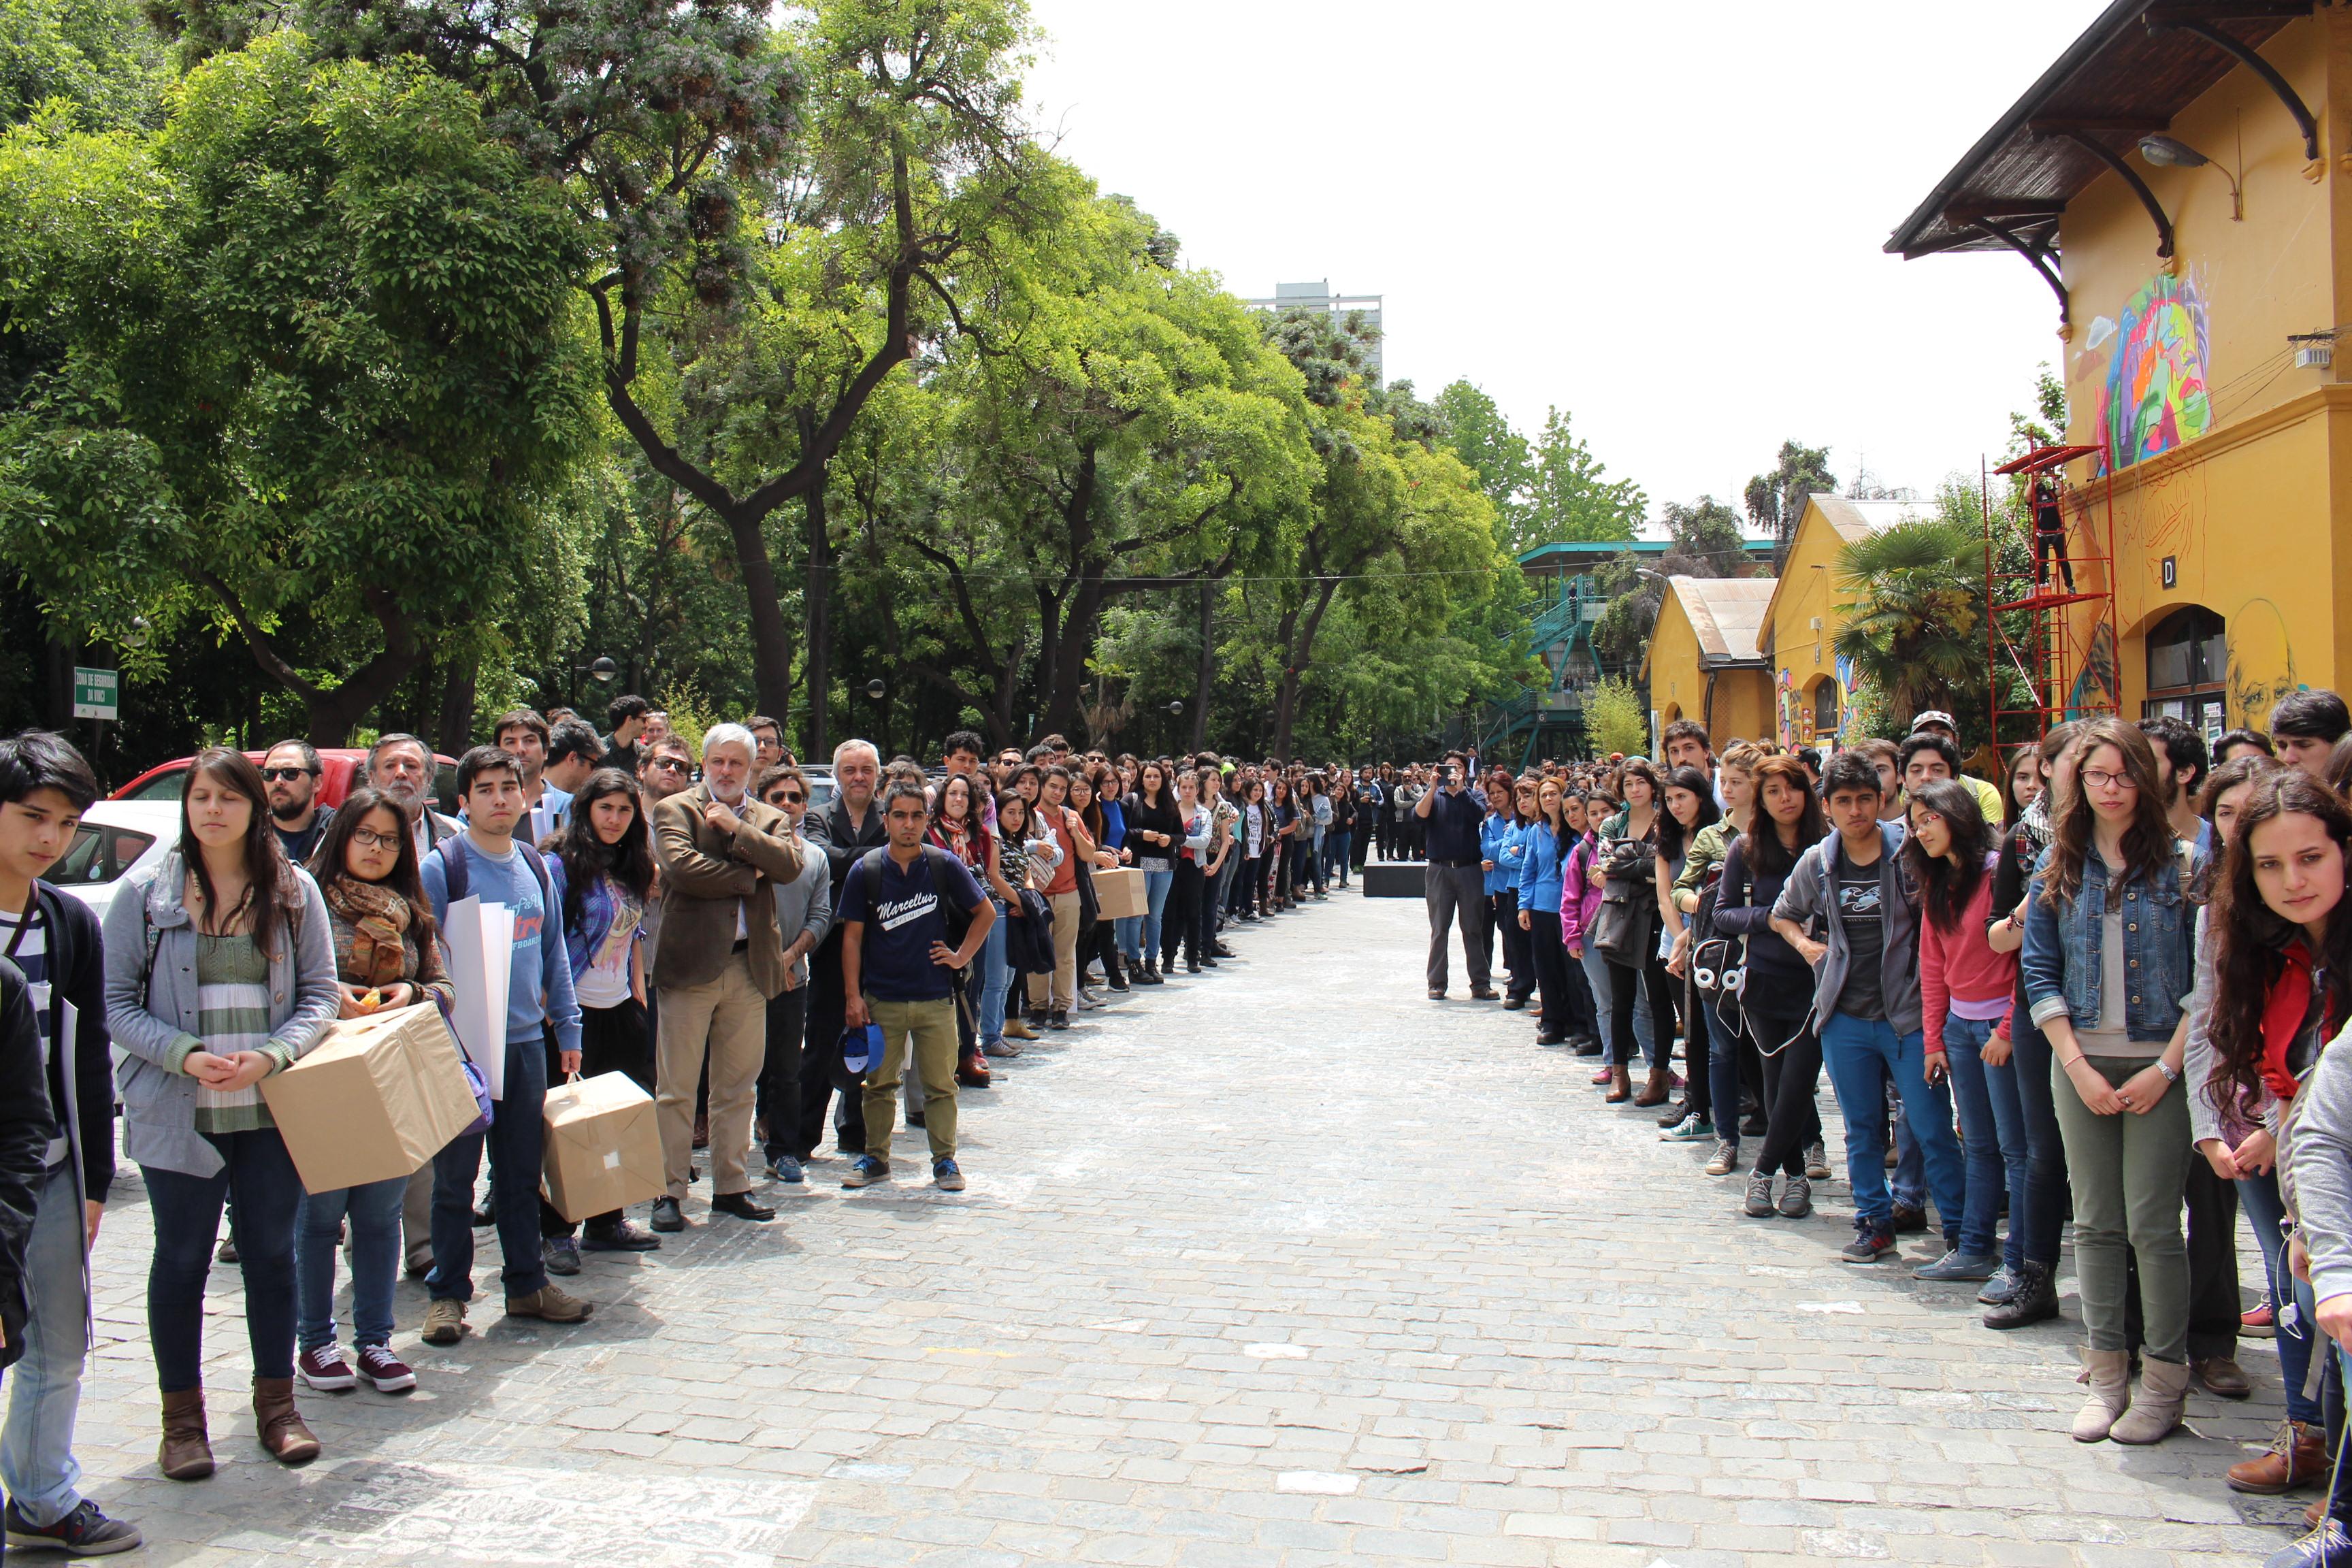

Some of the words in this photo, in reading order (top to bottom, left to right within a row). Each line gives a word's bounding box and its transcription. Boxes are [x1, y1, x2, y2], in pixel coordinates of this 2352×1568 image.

[2165, 561, 2172, 584] D
[76, 672, 87, 685] ZONA
[88, 674, 93, 686] DE
[94, 674, 116, 689] SEGURIDAD
[87, 689, 94, 702] DA
[94, 689, 105, 702] VINCI
[877, 892, 933, 919] Marcellus
[892, 909, 924, 925] OPTIMIST
